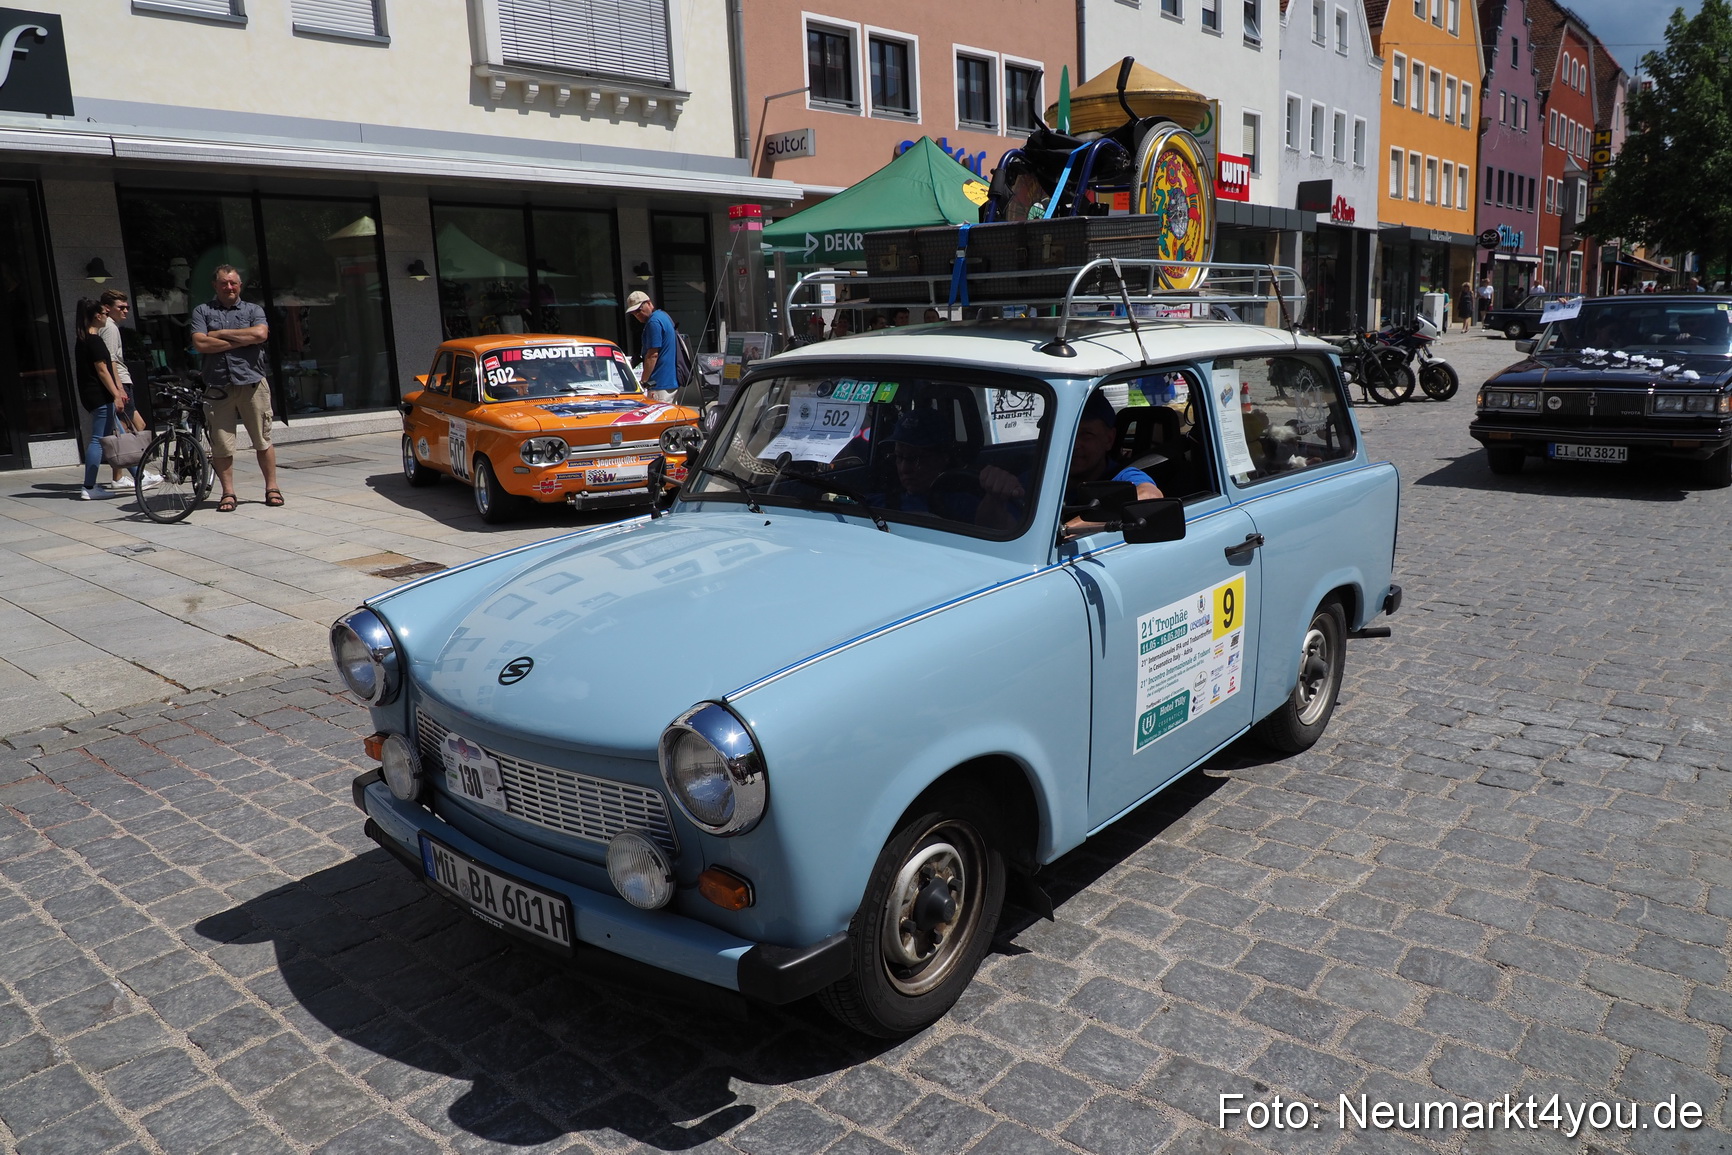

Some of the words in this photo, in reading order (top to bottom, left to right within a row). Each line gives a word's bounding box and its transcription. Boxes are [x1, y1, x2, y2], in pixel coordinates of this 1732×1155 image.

[767, 136, 807, 156] sutor.
[1221, 160, 1249, 186] WITT
[824, 232, 865, 251] DEKR
[522, 346, 594, 360] SANDTLER
[487, 367, 517, 387] 502
[822, 409, 850, 427] 502
[1555, 445, 1569, 456] EI
[1577, 446, 1592, 458] CR
[1593, 447, 1616, 459] 382
[1222, 587, 1235, 629] 9
[1156, 609, 1188, 633] Trophäe
[1160, 701, 1174, 716] Hotel
[458, 763, 484, 800] 130
[432, 845, 459, 892] MÜ
[467, 866, 498, 913] BA
[502, 884, 569, 943] 601H
